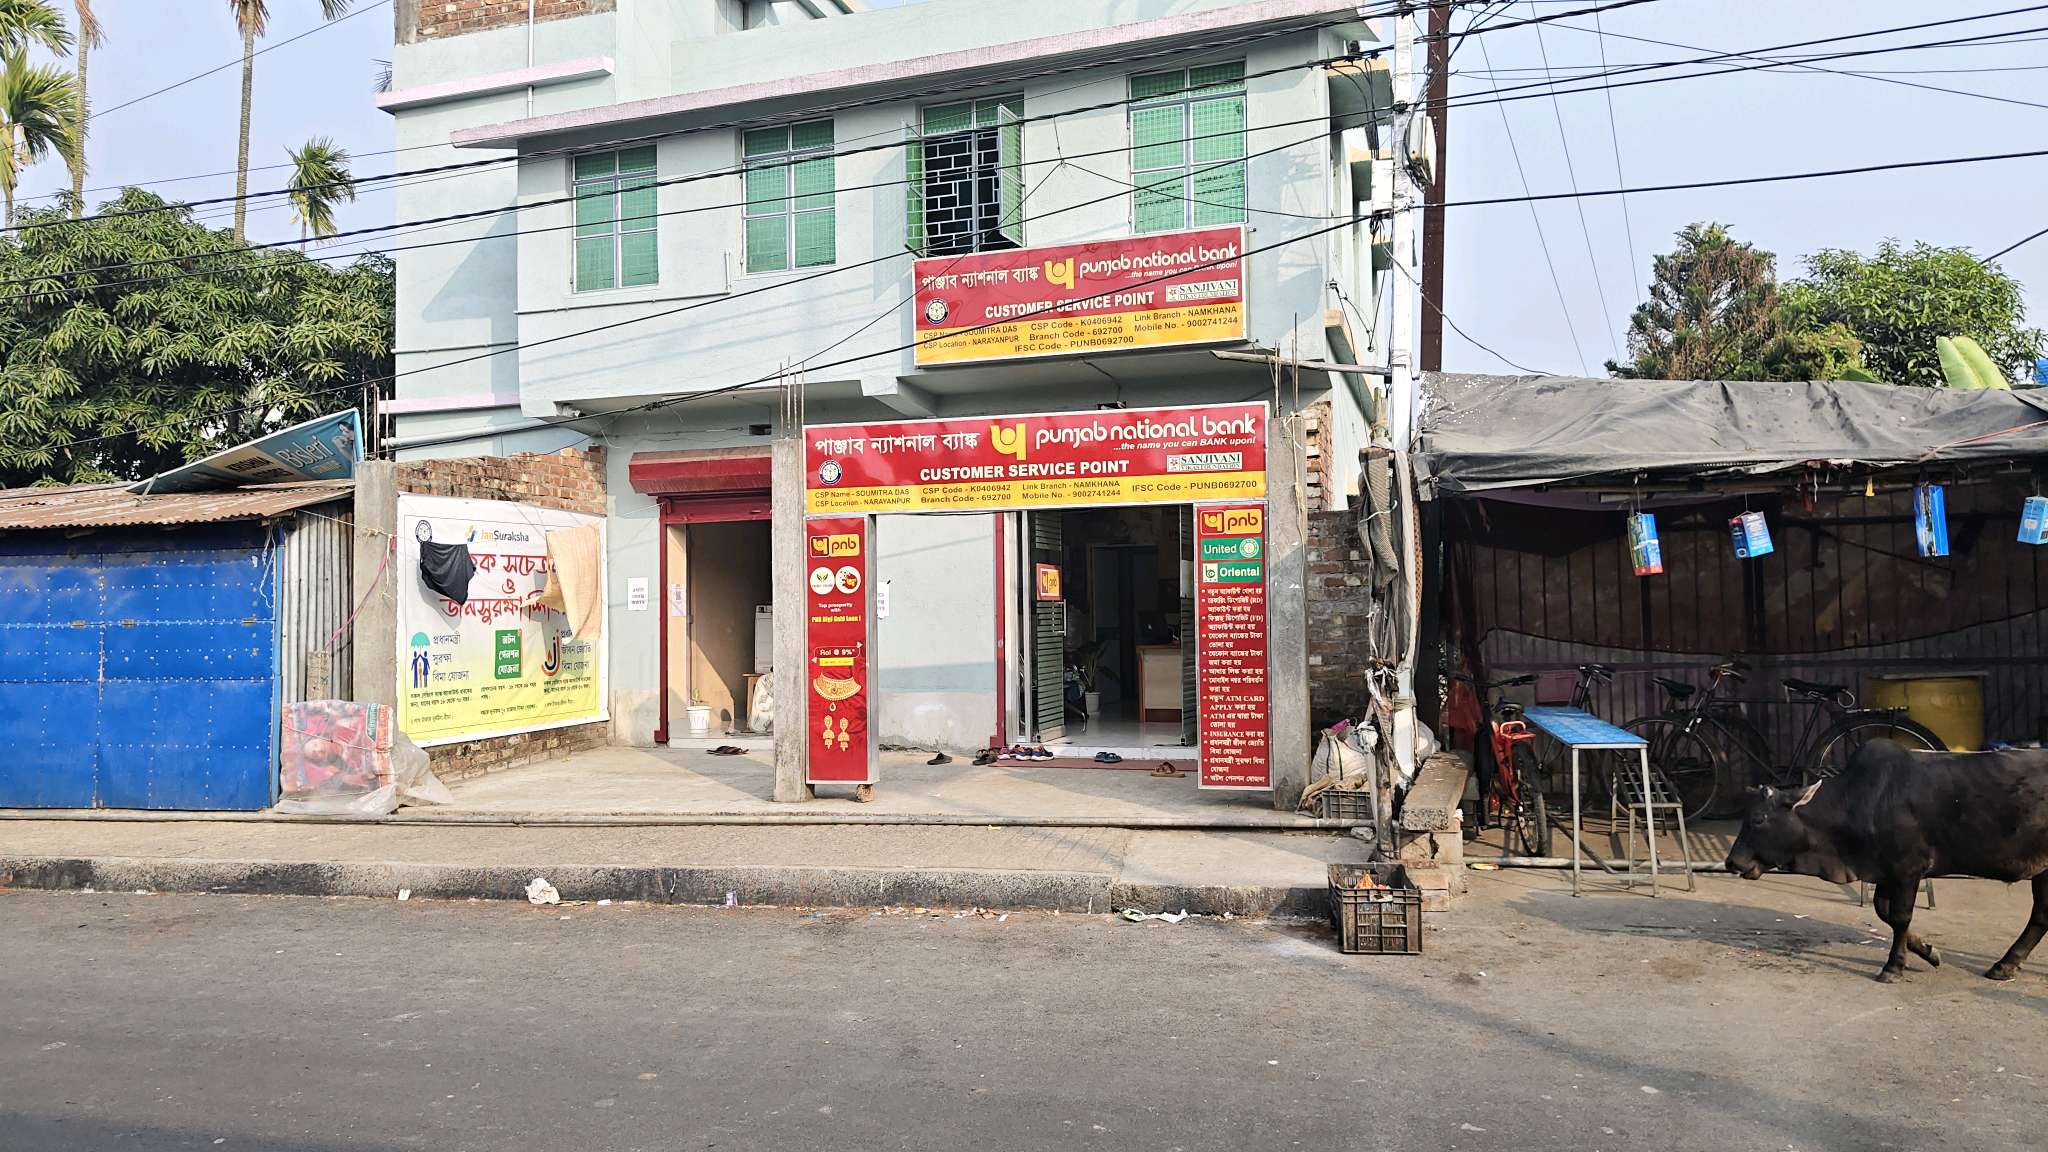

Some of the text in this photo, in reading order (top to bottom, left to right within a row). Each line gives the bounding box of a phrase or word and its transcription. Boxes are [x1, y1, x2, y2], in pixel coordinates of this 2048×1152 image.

[1079, 242, 1238, 279] punjab national bank
[921, 266, 1041, 291] পাঞ্জাব ন্যাশনাল ব্যাঙ্ক
[1144, 269, 1163, 277] name
[1164, 267, 1178, 276] you
[1179, 280, 1237, 292] SANJIVANI
[985, 291, 1155, 319] CUSTOMER SERVICE POINT
[1134, 306, 1237, 322] Link Branch NAMKHANA
[1031, 316, 1122, 330] CSP Code K0406942
[1134, 323, 1163, 332] Mobile
[1186, 317, 1238, 328] 9002741244
[924, 331, 938, 339] CSP
[1029, 327, 1123, 341] Branch Code 692700
[940, 340, 966, 348] Location
[972, 336, 1019, 345] NARAYANPUR
[1015, 336, 1134, 352] IFSC Code PUNB0692700
[1036, 412, 1256, 449] punjab national bank
[815, 431, 981, 456] পাঞ্জাব ন্যাশনাল ব্যাঙ্ক
[1137, 440, 1161, 449] name
[1163, 439, 1180, 450] you
[1181, 438, 1198, 447] can
[1200, 437, 1227, 446] BANK
[1229, 436, 1256, 447] upon!
[275, 435, 334, 469] Bisleri
[1181, 453, 1241, 464] SANJIVANI
[920, 459, 1129, 481] CUSTOMER SERVICE POINT
[922, 484, 1012, 495] CSP Code K0406942
[1022, 480, 1120, 490] Link Branch NAMKHANA
[1132, 480, 1257, 493] IFSC Code PUNB0692700
[815, 491, 830, 499] CSP
[831, 490, 850, 498] Name
[856, 489, 893, 497] SOUMITRA
[921, 493, 1012, 504] Branch Code 692700
[1022, 491, 1049, 500] Mobile
[1072, 489, 1121, 498] 9002741244
[815, 497, 911, 508] CSP Location NARAYANPUR
[1228, 512, 1258, 530] pnb
[480, 530, 530, 543] JanSuraksha
[832, 537, 856, 554] pnb
[1204, 544, 1237, 554] United
[1220, 566, 1260, 577] Oriental
[502, 578, 516, 594] ও
[440, 596, 523, 625] জনসুরক্ষা
[433, 631, 461, 645] প্রধানমন্ত্রী
[432, 653, 452, 666] সুরক্ষা
[433, 669, 470, 682] বিমা যোজনা
[498, 663, 519, 675] যোজনা
